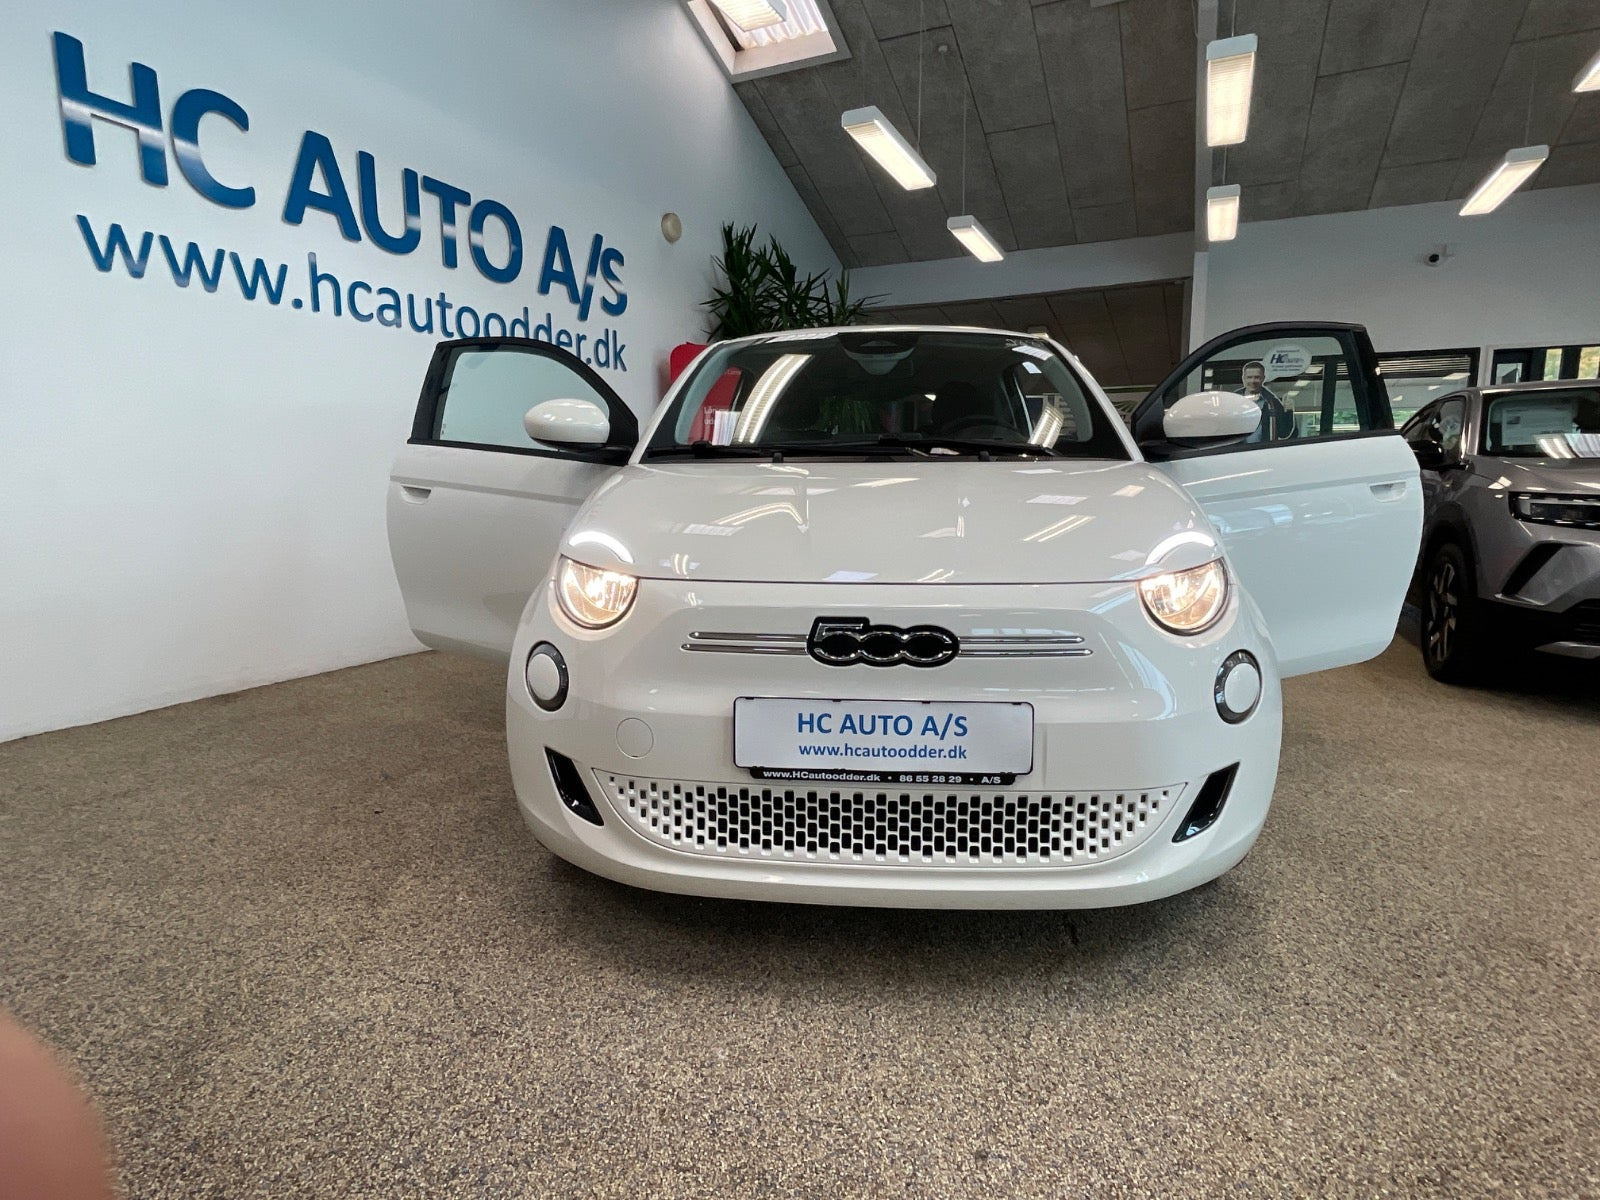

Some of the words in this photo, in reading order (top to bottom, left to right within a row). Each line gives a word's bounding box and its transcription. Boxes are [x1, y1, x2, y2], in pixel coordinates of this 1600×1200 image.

[52, 31, 256, 209] HC
[281, 130, 523, 284] AUTO
[537, 225, 628, 321] A/S
[76, 213, 628, 372] www.hcautoodder.dk
[797, 712, 832, 734] HC
[839, 714, 913, 736] AUTO
[921, 714, 968, 741] A/S
[798, 742, 967, 760] www.hcautoodder.dk
[763, 769, 881, 783] www.HCautoodder.dk
[899, 774, 913, 783] 86
[915, 775, 929, 783] 55
[932, 775, 946, 784] 28
[949, 775, 962, 784] 29
[981, 776, 1001, 785] A/S
